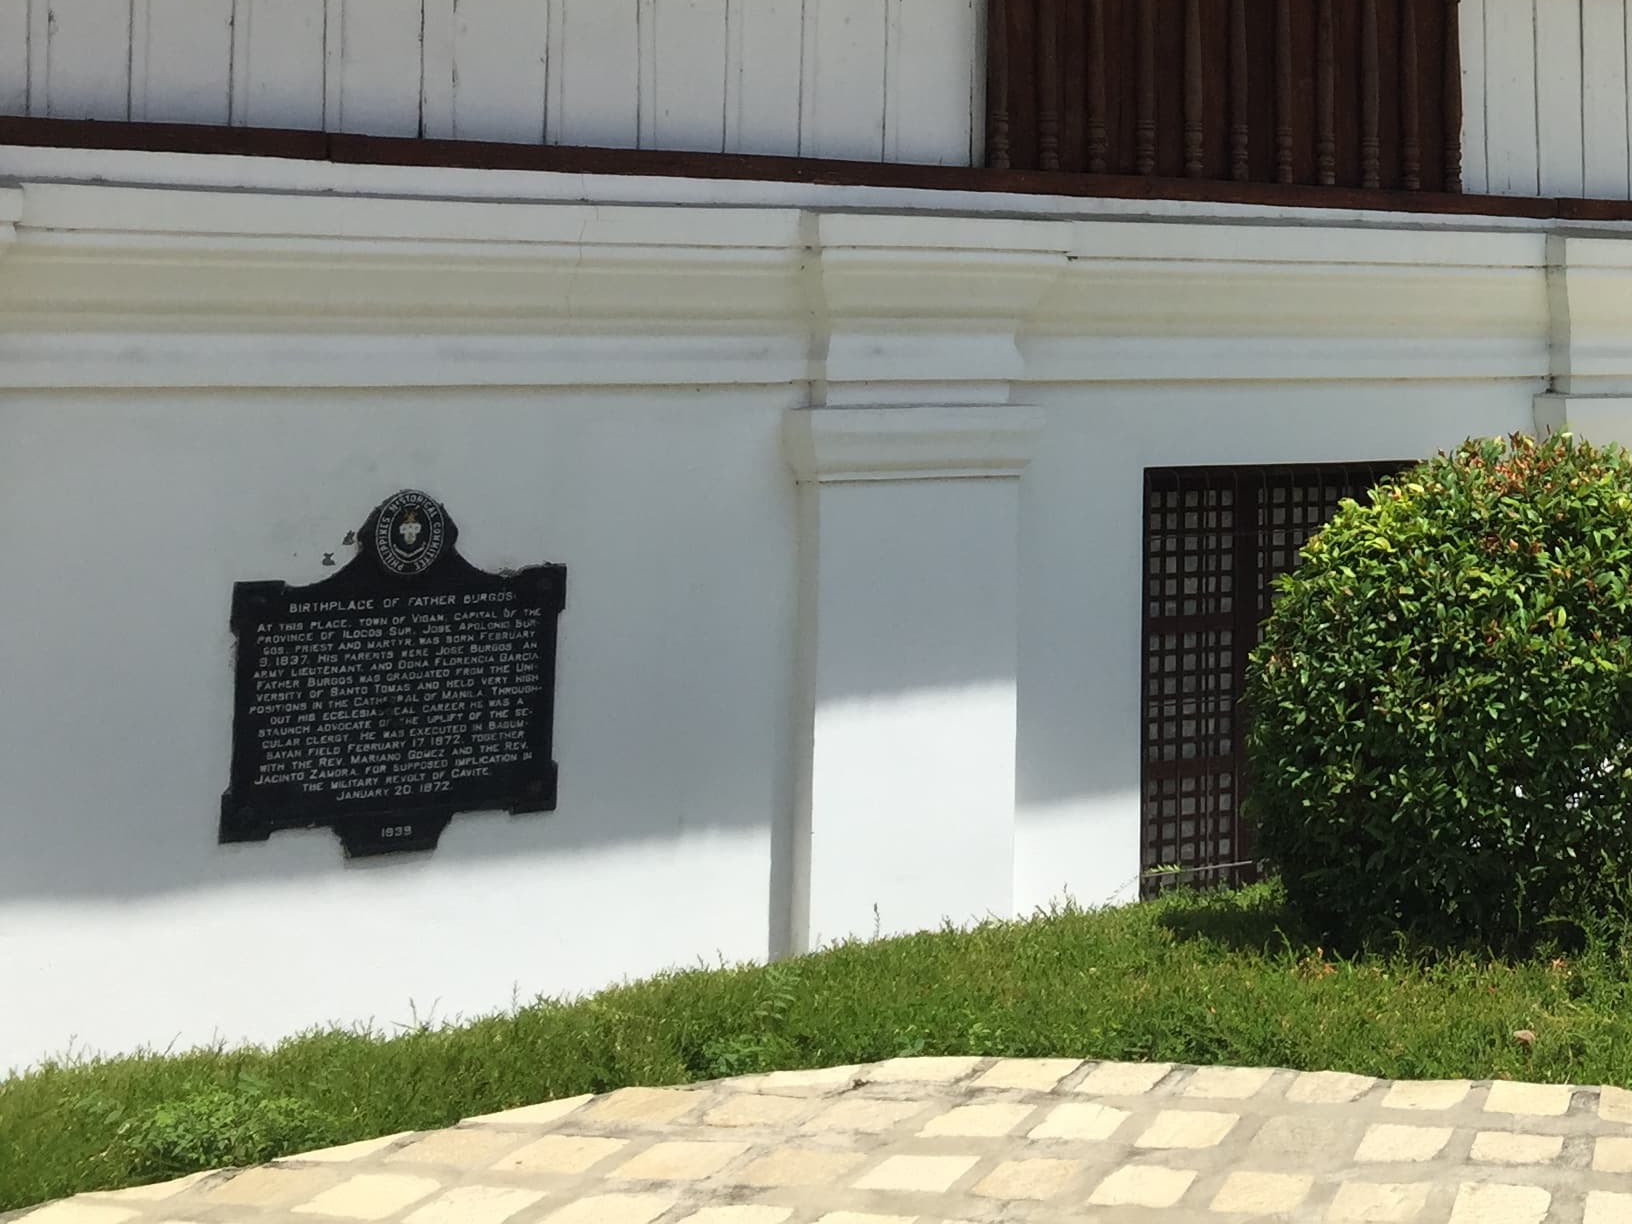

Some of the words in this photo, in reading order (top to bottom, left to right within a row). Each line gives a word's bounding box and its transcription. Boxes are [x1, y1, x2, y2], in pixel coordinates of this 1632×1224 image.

[388, 494, 439, 518] HISTORICAL
[289, 599, 374, 613] BIRTHPLACE
[383, 598, 400, 608] OF
[408, 594, 456, 607] FATHER
[257, 624, 272, 633] AT
[280, 622, 303, 631] THIS
[360, 617, 387, 626] TOWN
[392, 616, 406, 625] OF
[454, 611, 497, 621] CAPITAL
[504, 608, 515, 618] OF
[524, 608, 542, 616] THE
[257, 632, 314, 645] PROVINCE
[320, 631, 334, 640] OF
[343, 629, 382, 639] ILOCOS
[422, 624, 452, 634] JOSE
[295, 643, 334, 653] PRIEST
[338, 641, 361, 650] AND
[419, 637, 440, 645] WAS
[446, 634, 474, 644] BORN
[480, 630, 536, 641] FEBRUARY
[317, 654, 338, 664] HIS
[344, 651, 394, 661] PARENTS
[401, 648, 429, 657] WERE
[435, 646, 464, 656] JOSE
[523, 642, 538, 650] AN
[253, 670, 284, 679] ARMY
[370, 662, 393, 671] AND
[434, 655, 495, 667] FLORENCIA
[256, 679, 300, 690] FATHER
[307, 676, 353, 687] BURGOS
[359, 674, 380, 683] WAS
[386, 670, 450, 681] GRADUATED
[455, 666, 484, 676] FROM
[489, 664, 510, 674] THE
[256, 692, 303, 703] VERSITY
[309, 690, 324, 699] OF
[331, 686, 368, 697] SANTO
[375, 683, 412, 693] TOMAS
[417, 681, 440, 690] AND
[446, 678, 474, 688] HELD
[481, 676, 508, 685] VERY
[515, 674, 539, 683] HIGH
[248, 703, 307, 715] POSITIONS
[312, 702, 323, 710] IN
[328, 699, 348, 709] THE
[423, 692, 437, 701] OF
[270, 715, 291, 725] OUT
[298, 714, 316, 723] HIS
[422, 702, 465, 713] CAREER
[470, 700, 483, 709] HE
[488, 698, 510, 707] WAS
[517, 697, 524, 705] A
[258, 726, 310, 738] STAUNCH
[317, 720, 372, 732] ADVOCATE
[427, 713, 464, 723] UPLIFT
[469, 711, 482, 720] OF
[490, 709, 509, 719] THE
[262, 738, 301, 749] CULAR
[360, 732, 376, 740] HE
[383, 729, 405, 738] WAS
[409, 724, 467, 737] EXECUTED
[473, 723, 482, 731] IN
[266, 749, 303, 761] BAYAN
[307, 746, 341, 757] FIELD
[347, 740, 406, 754] FEBRUARY
[471, 730, 525, 742] TOGETHER
[254, 771, 305, 785] JACINTO
[365, 765, 387, 774] FOR
[392, 759, 449, 772] SUPPOSED
[455, 753, 518, 766] IMPLICATION
[523, 752, 533, 761] IN
[259, 763, 285, 773] WITH
[292, 760, 313, 769] THE
[350, 753, 401, 765] MARIANO
[407, 749, 445, 760] GOMEZ
[451, 746, 473, 756] AND
[480, 744, 499, 753] THE
[302, 782, 325, 792] THE
[330, 777, 379, 790] MILITARY
[385, 772, 426, 785] REVOLT
[432, 771, 445, 780] OF
[336, 788, 389, 801] JANUARY
